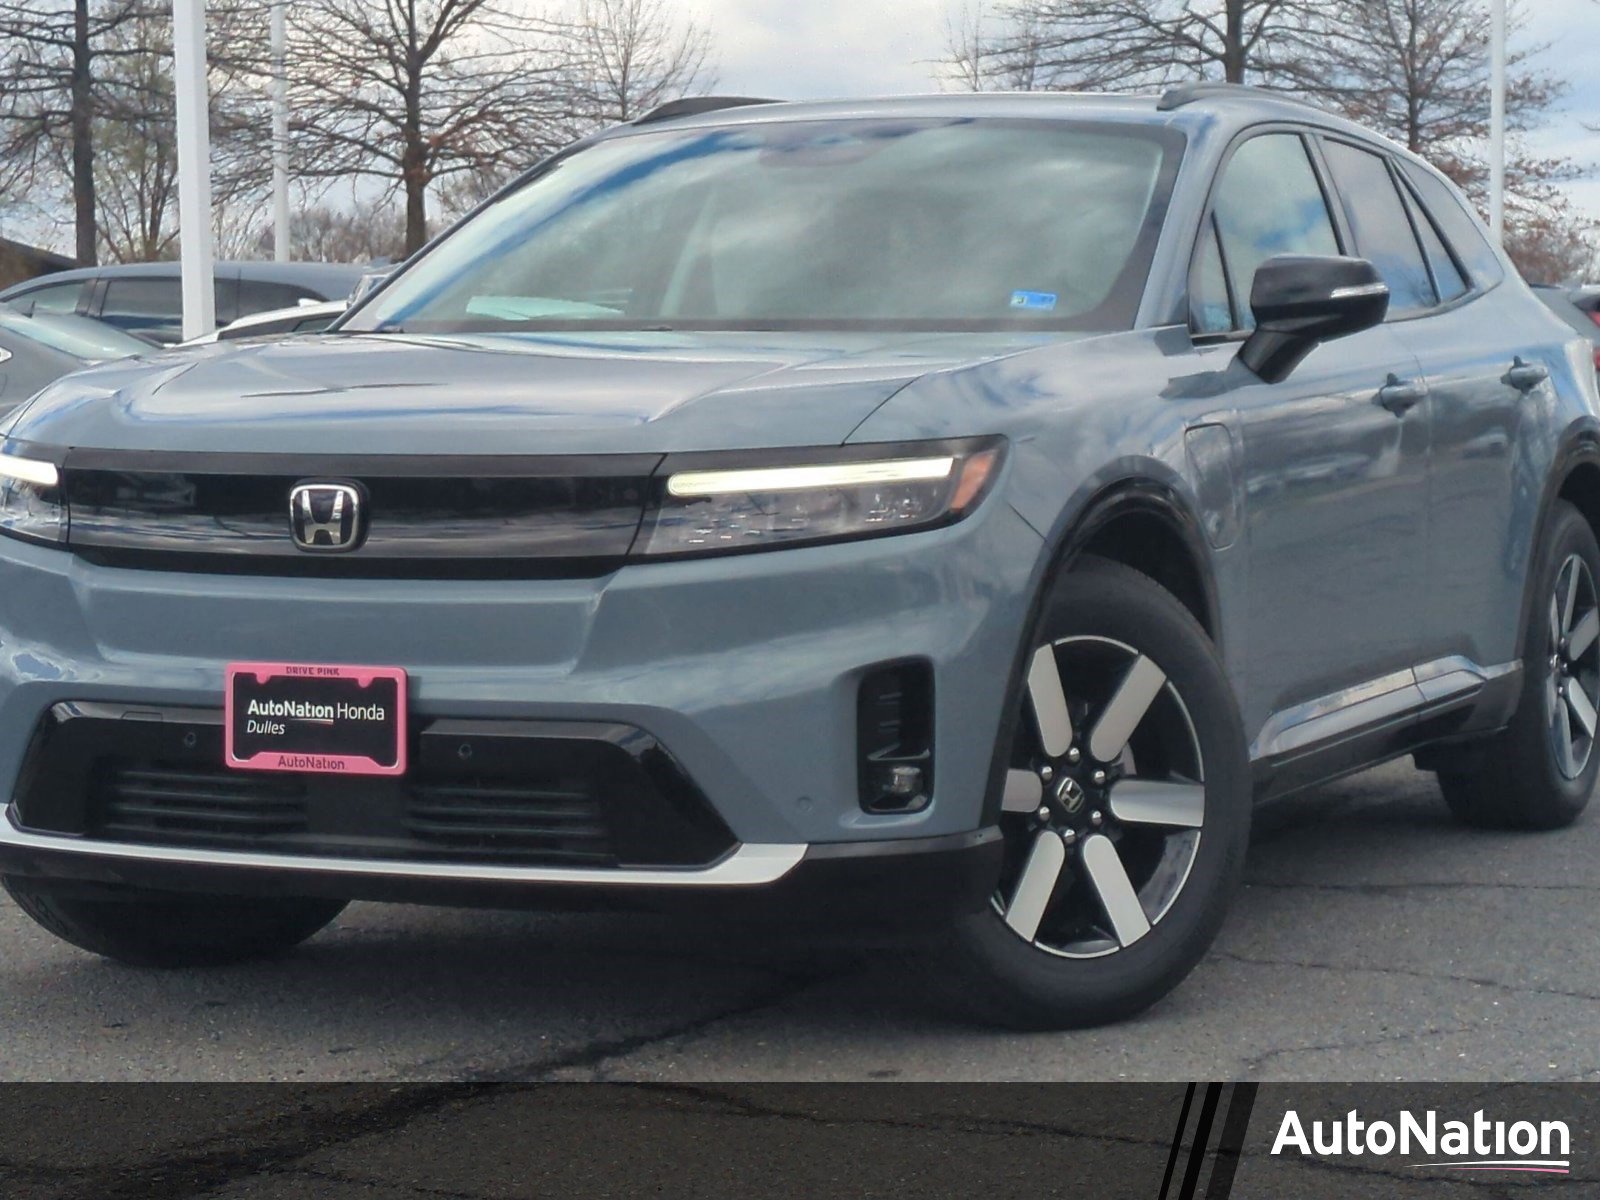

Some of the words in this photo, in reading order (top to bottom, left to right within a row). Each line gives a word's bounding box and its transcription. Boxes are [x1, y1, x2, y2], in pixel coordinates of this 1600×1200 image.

[286, 666, 314, 675] DRIVE
[317, 667, 340, 676] PINK
[247, 699, 334, 719] AutoNation
[337, 702, 385, 721] Honda
[247, 719, 285, 735] Dulles
[278, 755, 345, 770] AutoNation
